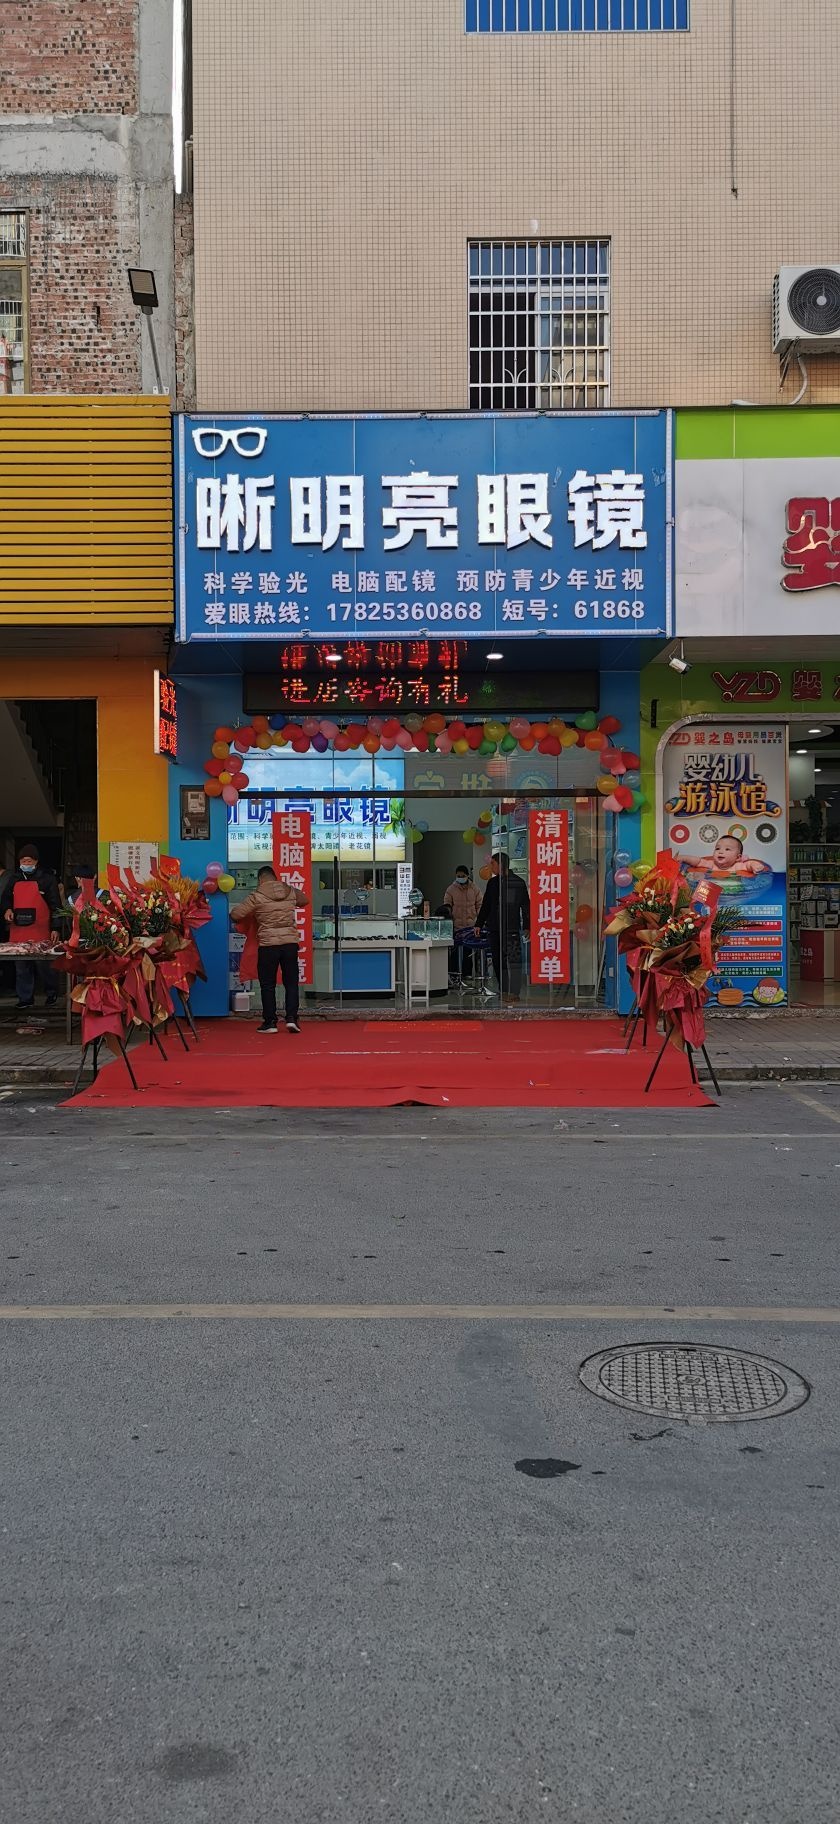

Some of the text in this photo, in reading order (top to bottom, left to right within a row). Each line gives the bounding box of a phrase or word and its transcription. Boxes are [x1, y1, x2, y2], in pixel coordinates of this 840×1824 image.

[196, 469, 648, 552] 晰明亮眼镜
[203, 568, 645, 594] 科学验光 电脑配镜 预防青少年近视
[327, 601, 482, 621] 17825360868
[574, 600, 645, 620] 61868
[694, 731, 735, 746] 婴之岛
[683, 753, 764, 783] 婴幼儿
[678, 782, 768, 815] 游泳馆
[536, 811, 564, 982] 清晰如此简单
